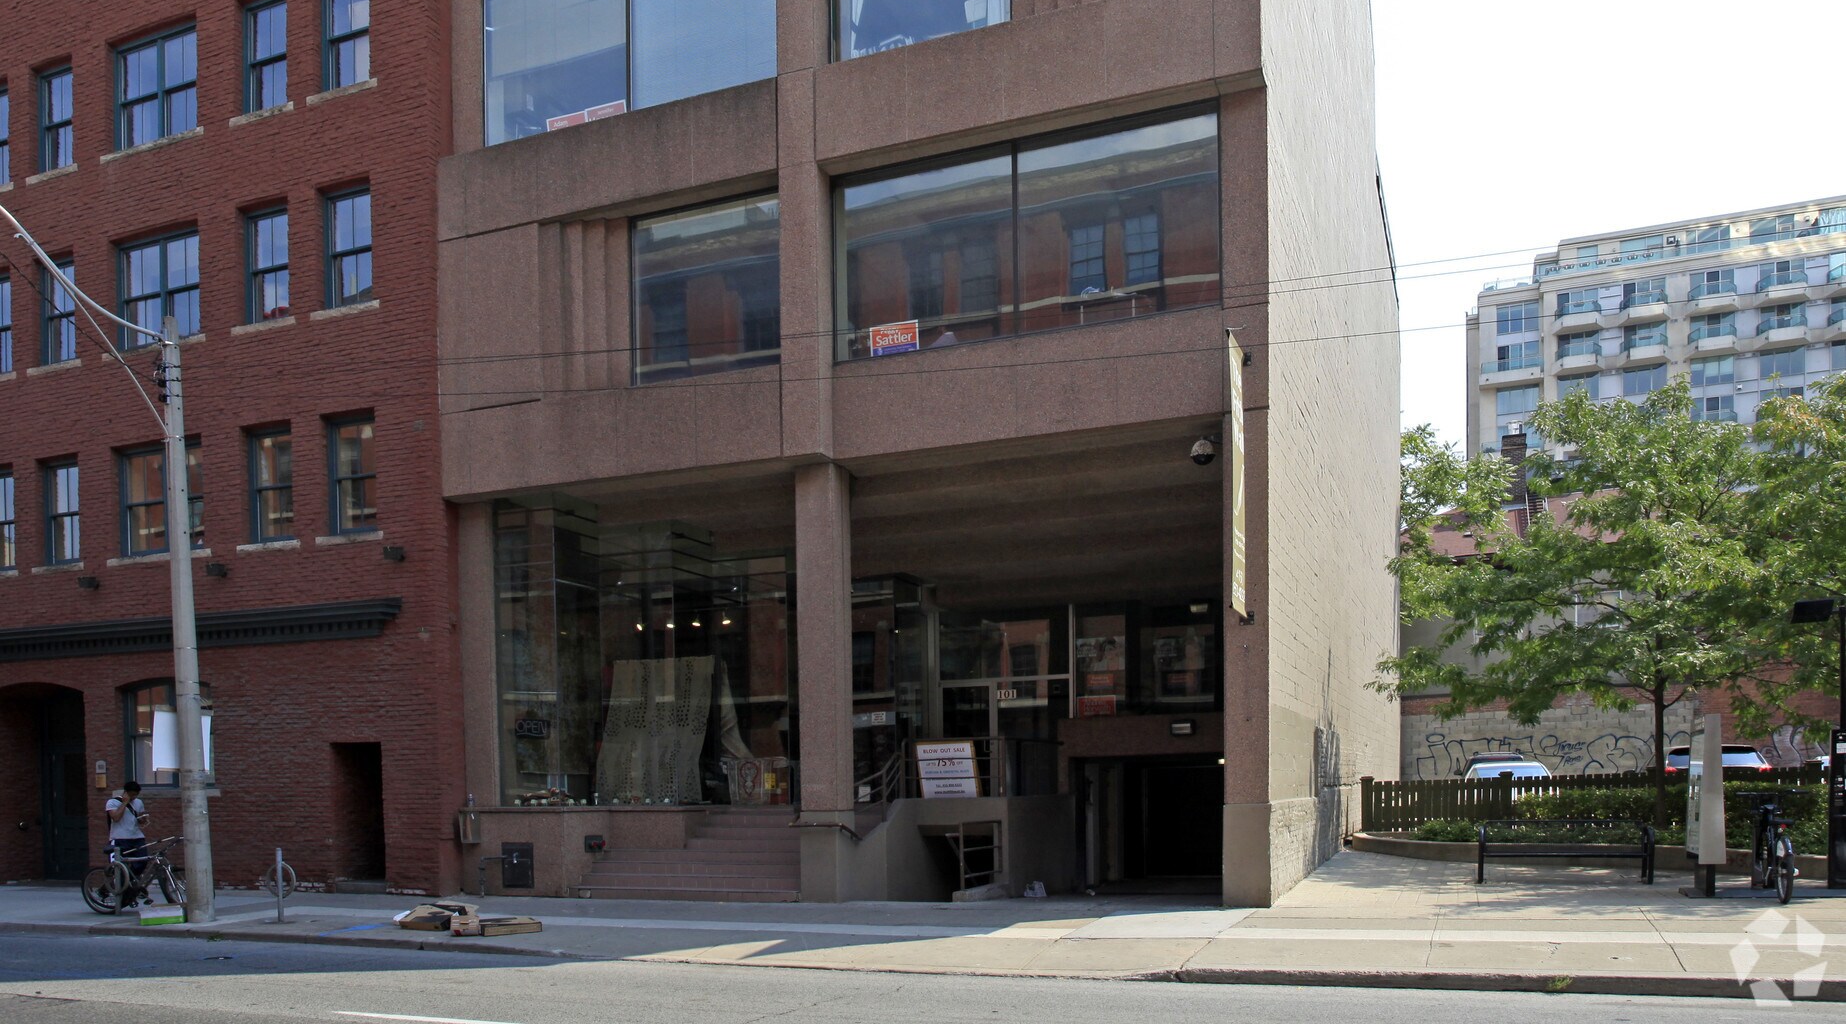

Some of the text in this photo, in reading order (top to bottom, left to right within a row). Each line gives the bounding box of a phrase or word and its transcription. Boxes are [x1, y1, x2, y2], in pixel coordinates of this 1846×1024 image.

[553, 120, 569, 128] Adam
[875, 331, 913, 347] Sattler
[999, 689, 1015, 699] 101
[515, 719, 548, 734] OPEN
